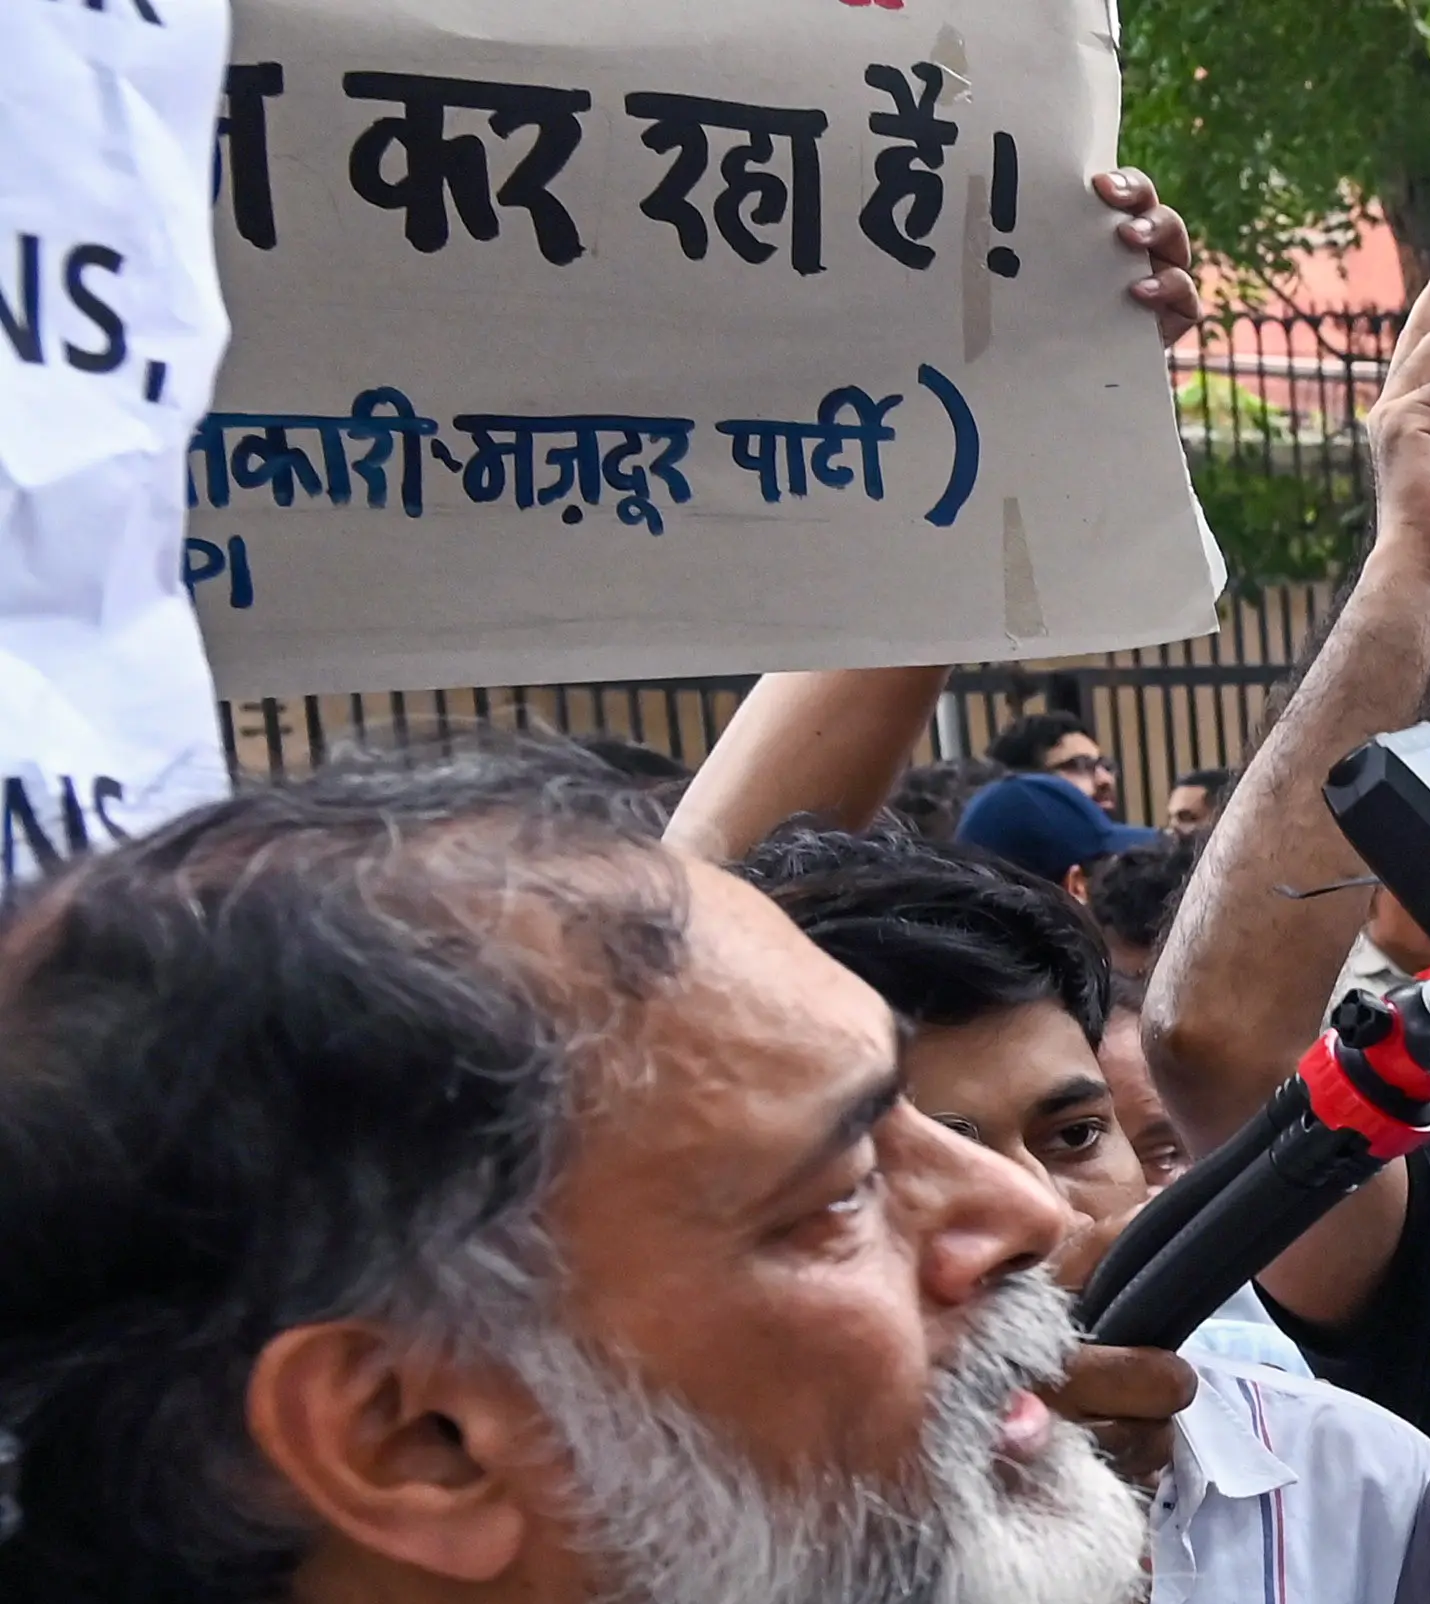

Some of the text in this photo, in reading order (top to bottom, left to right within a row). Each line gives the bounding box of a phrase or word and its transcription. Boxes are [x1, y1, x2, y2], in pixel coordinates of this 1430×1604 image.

[342, 68, 592, 268] कर
[624, 91, 829, 276] रहा
[184, 534, 254, 609] PI
